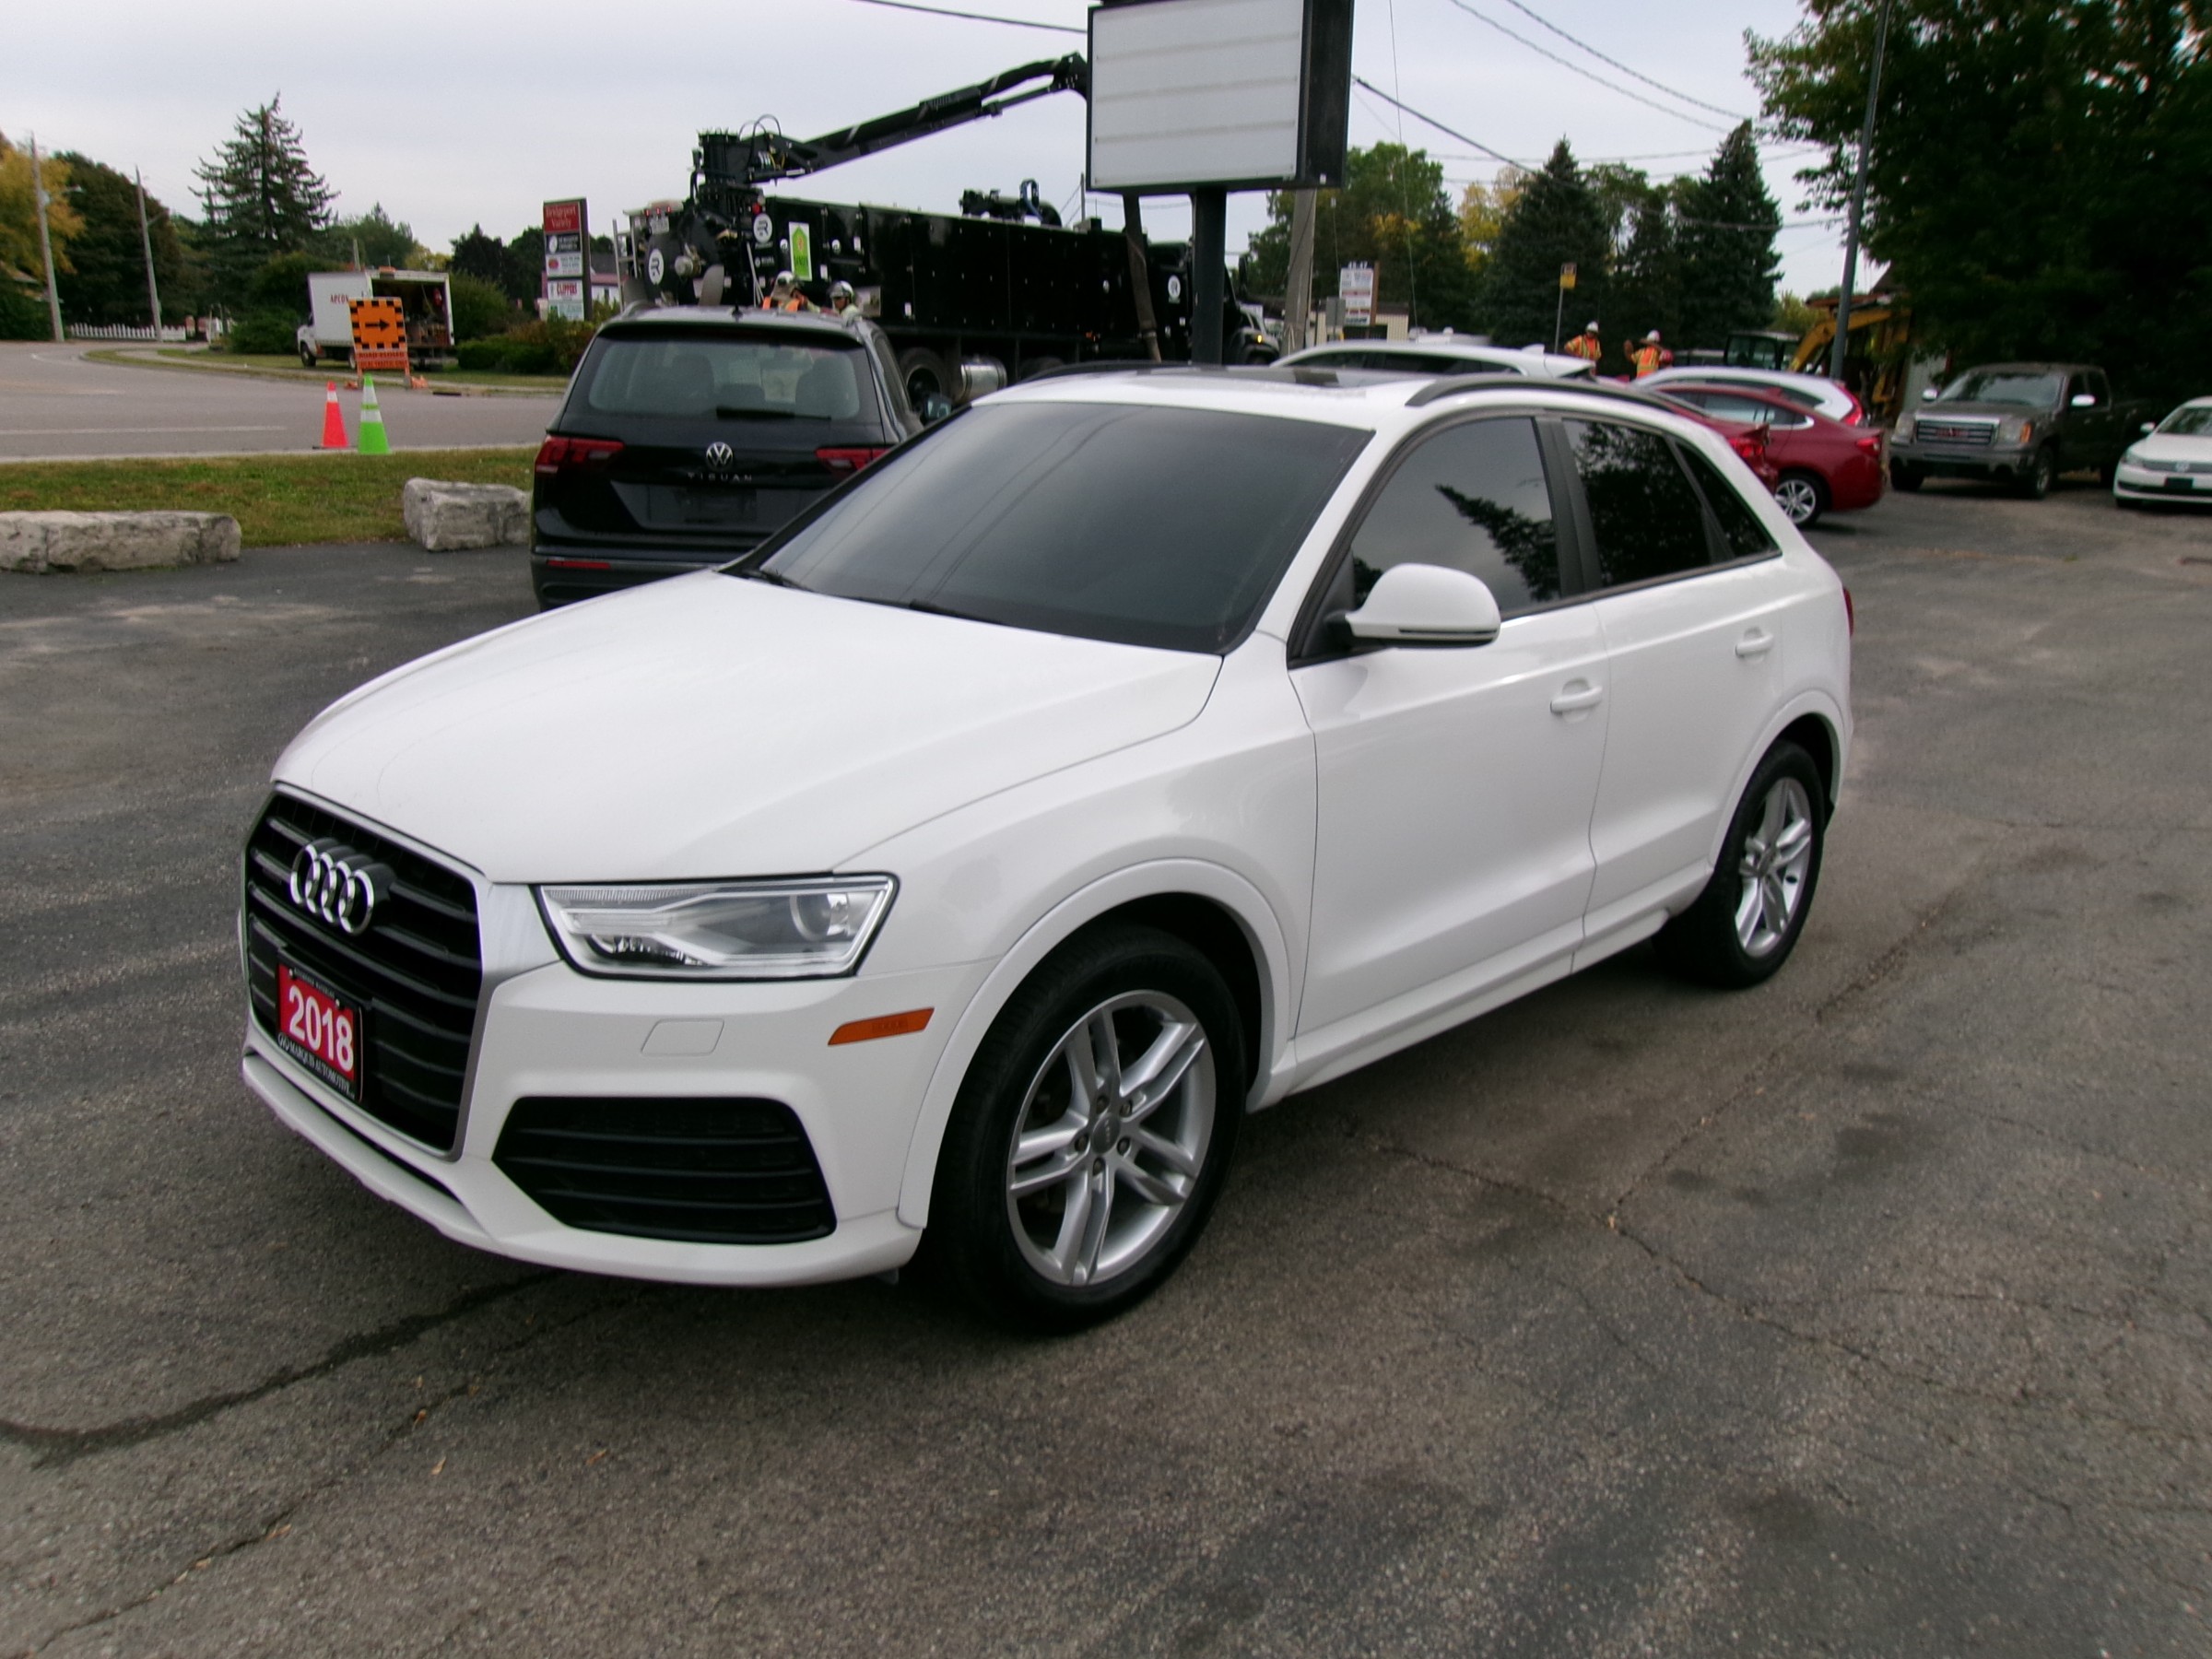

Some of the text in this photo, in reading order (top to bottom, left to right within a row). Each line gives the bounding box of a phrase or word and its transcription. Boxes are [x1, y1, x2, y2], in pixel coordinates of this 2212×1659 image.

[551, 218, 571, 229] Variety
[688, 472, 752, 482] TIGUAN
[288, 984, 354, 1072] 2018
[314, 1057, 350, 1095] AUTOMOTIVE
